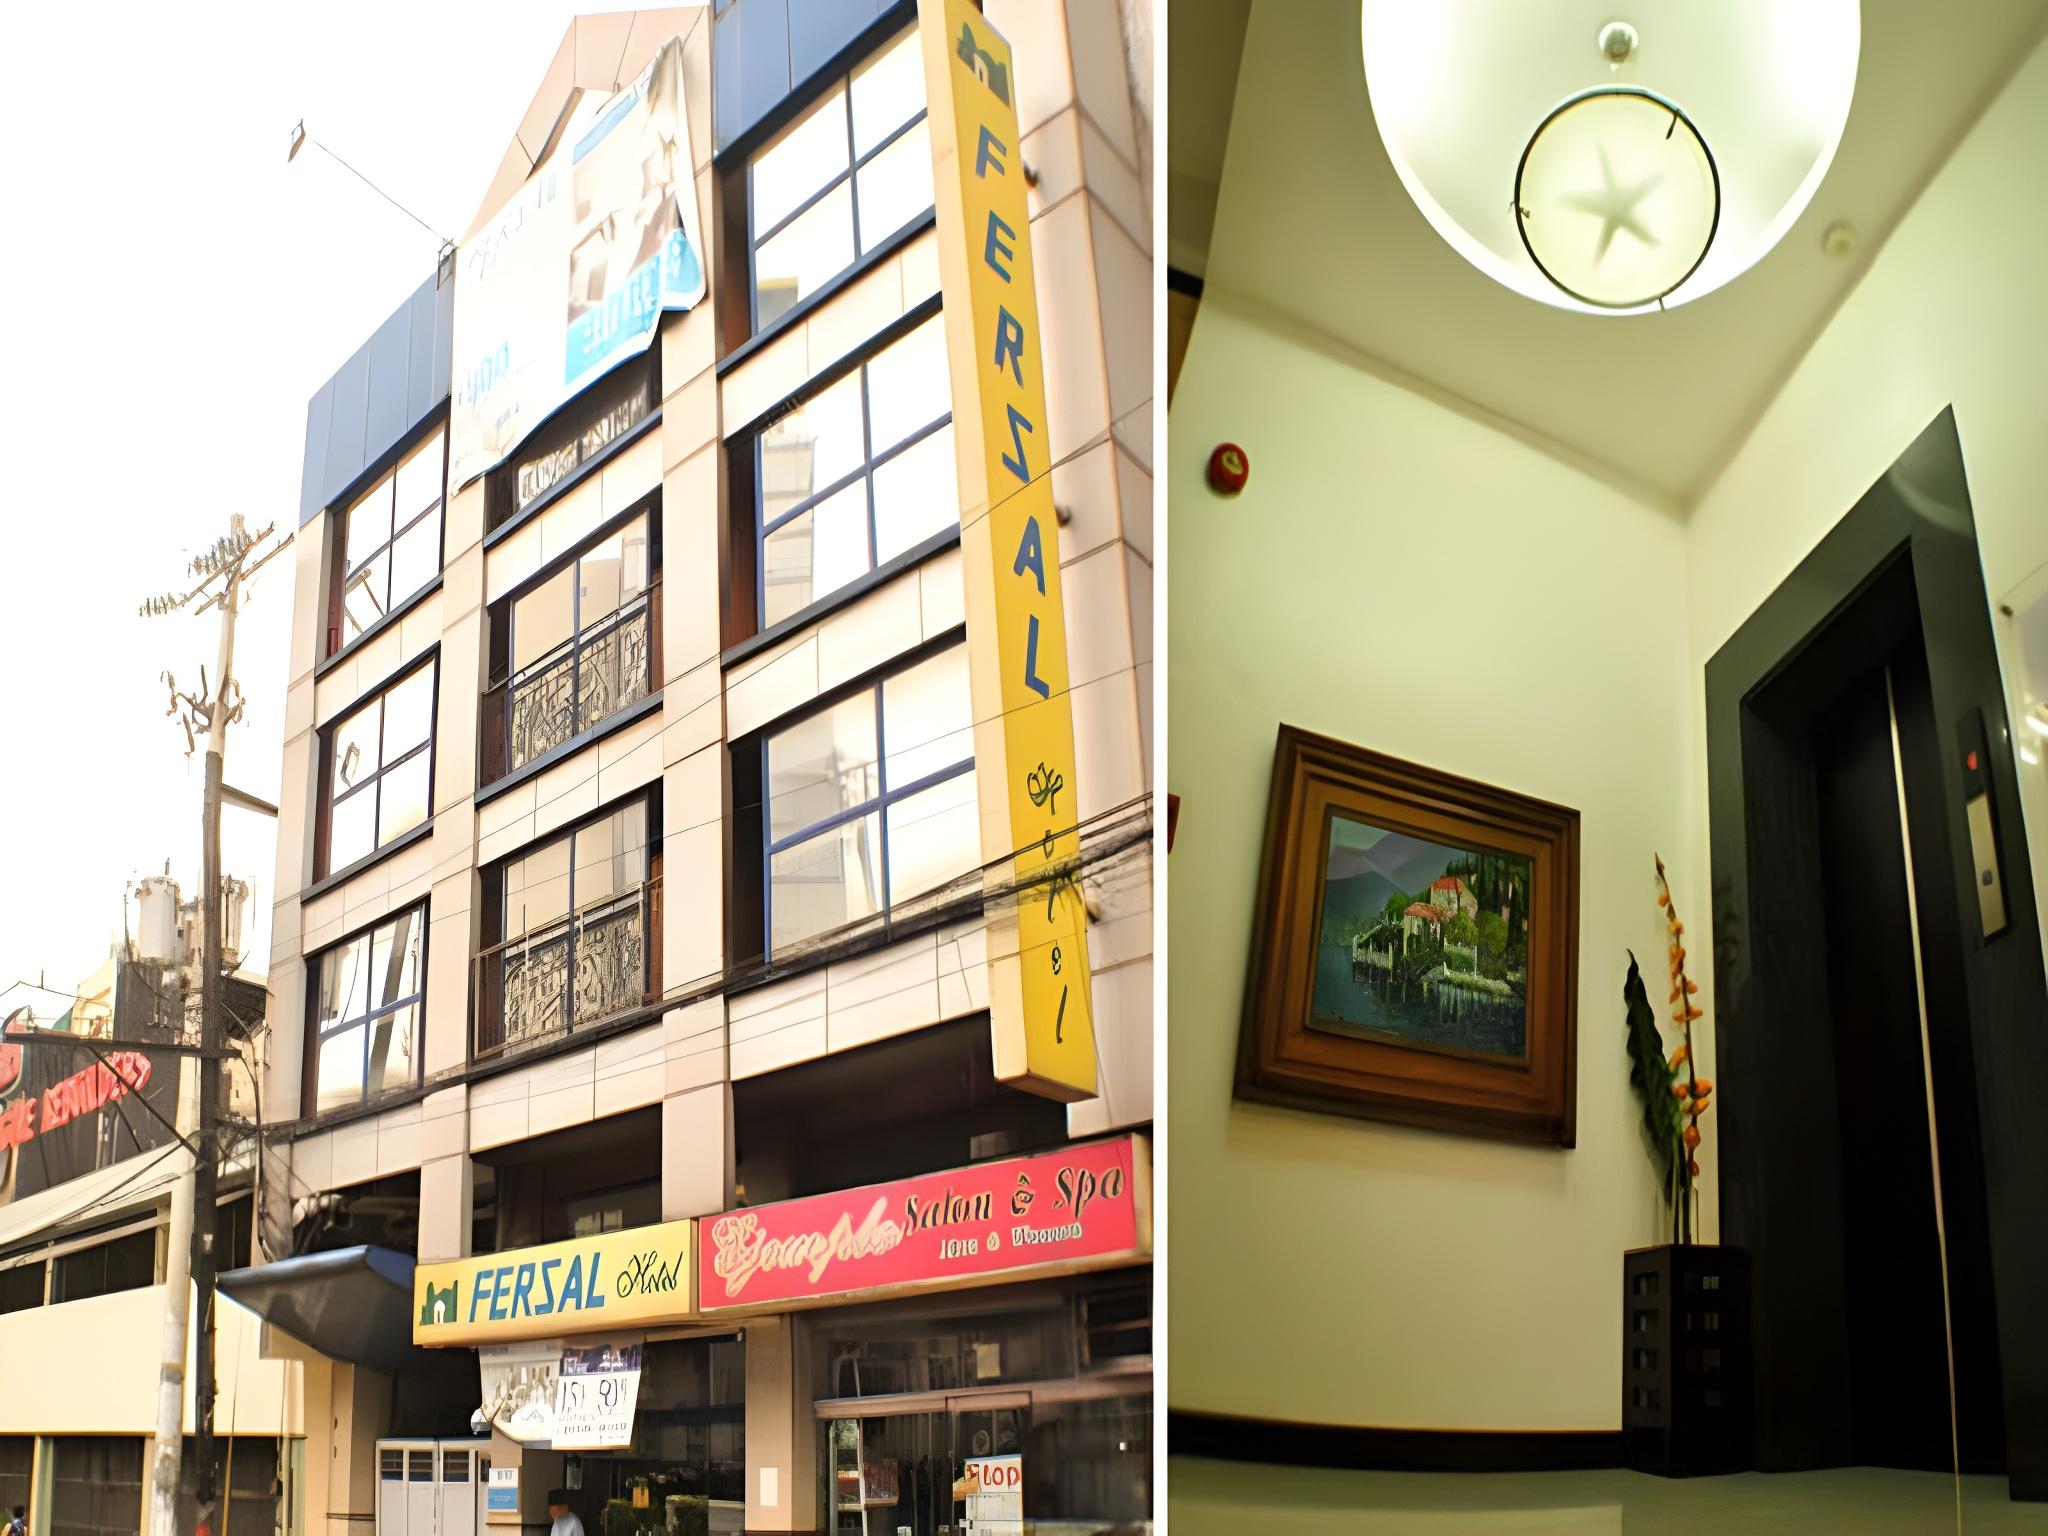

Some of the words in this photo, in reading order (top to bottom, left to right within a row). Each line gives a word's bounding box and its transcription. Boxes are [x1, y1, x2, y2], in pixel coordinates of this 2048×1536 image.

[976, 122, 1049, 700] FERSAL
[1052, 1166, 1125, 1221] Spa
[468, 1251, 606, 1323] FERSAL
